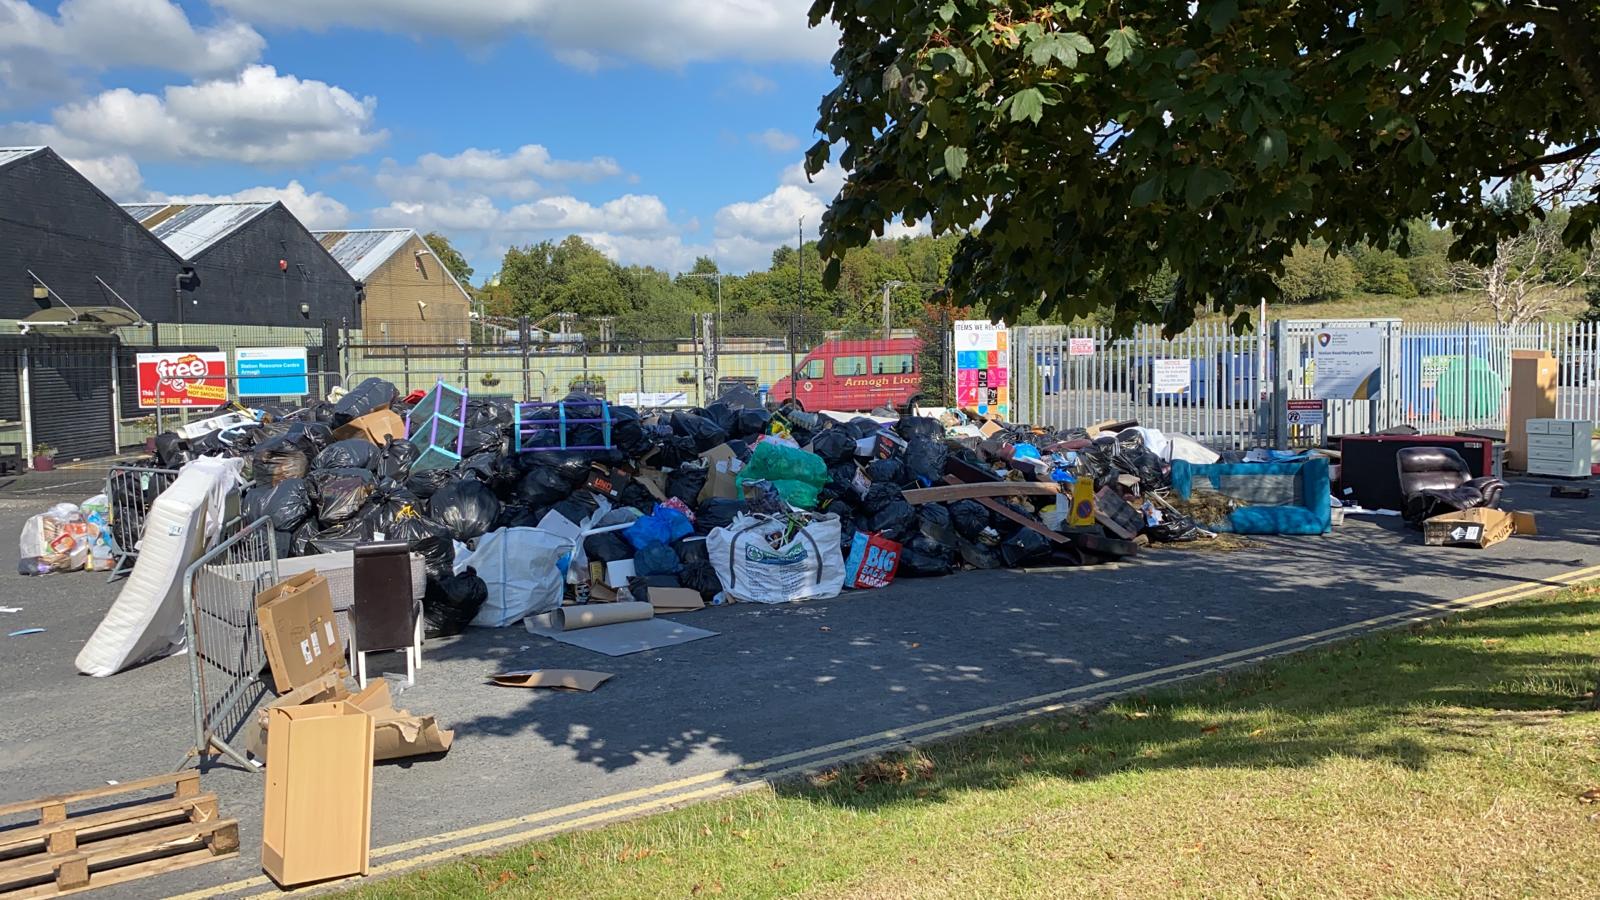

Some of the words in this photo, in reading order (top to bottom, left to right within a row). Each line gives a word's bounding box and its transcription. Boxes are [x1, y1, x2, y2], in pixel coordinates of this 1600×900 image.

[158, 360, 205, 377] free
[844, 378, 889, 387] Armagh
[893, 376, 922, 385] Lions
[200, 391, 225, 399] SMOKING
[865, 545, 896, 572] BIG
[862, 565, 879, 577] BAG
